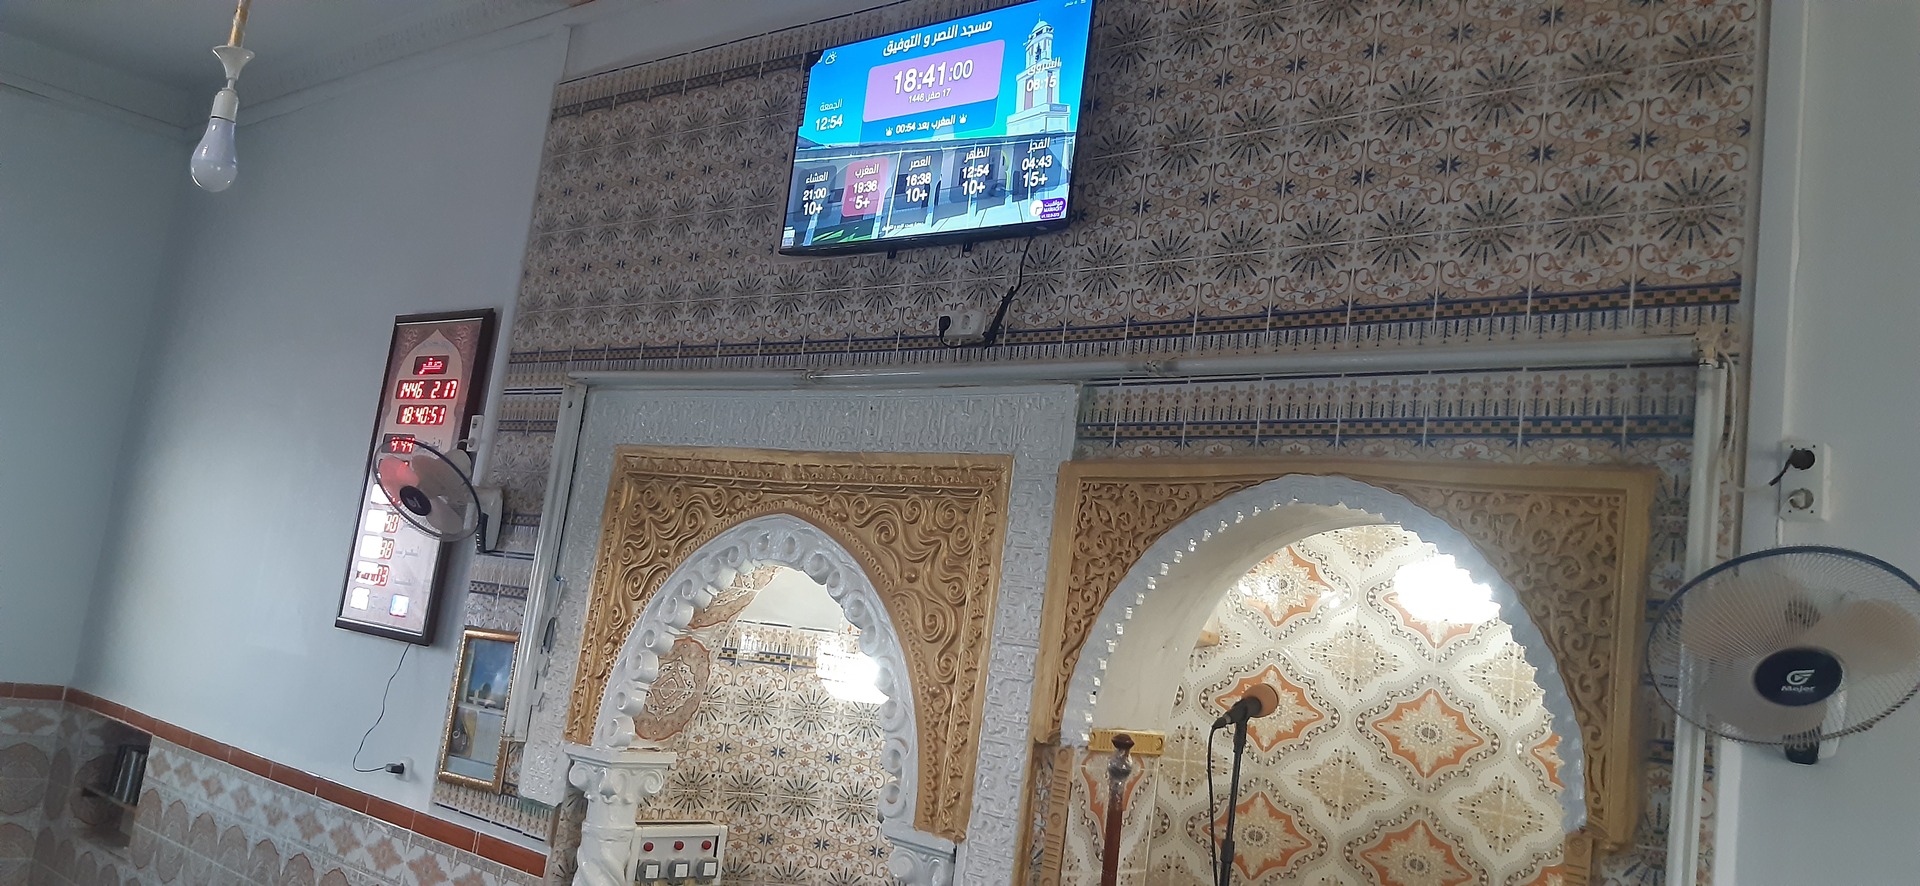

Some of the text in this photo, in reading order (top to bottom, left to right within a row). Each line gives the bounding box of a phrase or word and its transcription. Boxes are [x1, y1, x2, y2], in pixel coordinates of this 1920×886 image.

[931, 24, 959, 46] النصر
[960, 20, 993, 38] مسجد
[882, 32, 922, 57] التوفيق
[892, 59, 974, 95] 18:41:00
[819, 98, 843, 112] الجمعة
[924, 91, 941, 103] صفر
[815, 114, 843, 132] 12:54
[916, 120, 931, 131] بعد
[931, 114, 957, 130] المغرب
[1027, 136, 1051, 154] الفجر
[908, 155, 932, 172] العصر
[963, 146, 991, 164] الظهر
[1021, 154, 1053, 172] 04:43
[805, 171, 829, 185] العشاء
[854, 163, 880, 179] المغرب
[962, 163, 990, 180] 12:54
[1022, 171, 1049, 188] 15+
[802, 187, 827, 201] 21:00
[905, 187, 928, 203] 10+
[962, 180, 986, 196] 10+
[803, 201, 823, 216] 10+
[401, 406, 446, 424] 18:40:51
